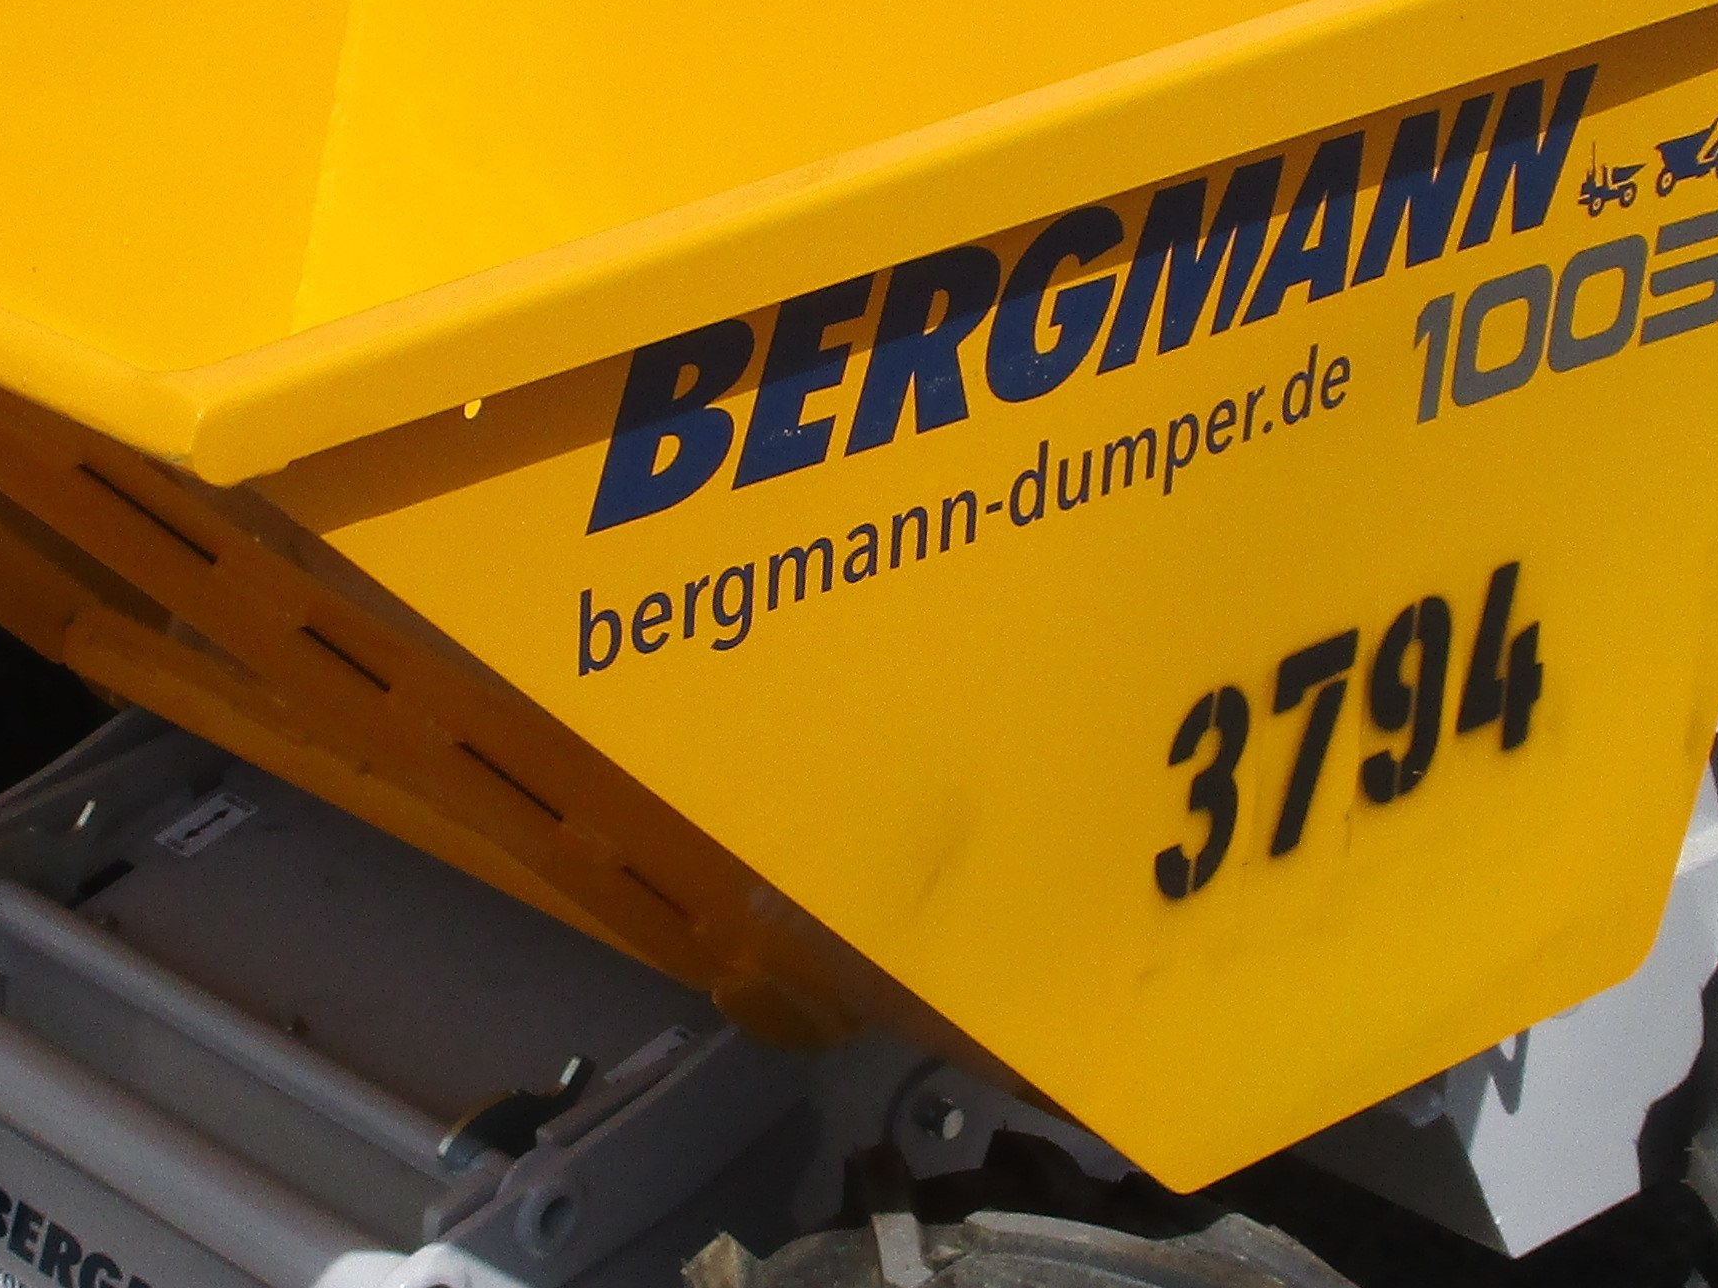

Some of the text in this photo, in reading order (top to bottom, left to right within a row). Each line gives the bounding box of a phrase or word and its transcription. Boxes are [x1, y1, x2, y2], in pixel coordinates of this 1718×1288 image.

[585, 63, 1599, 535] BERGMANN
[577, 345, 1354, 676] bergmann-dumper.de
[1152, 561, 1547, 903] 3794
